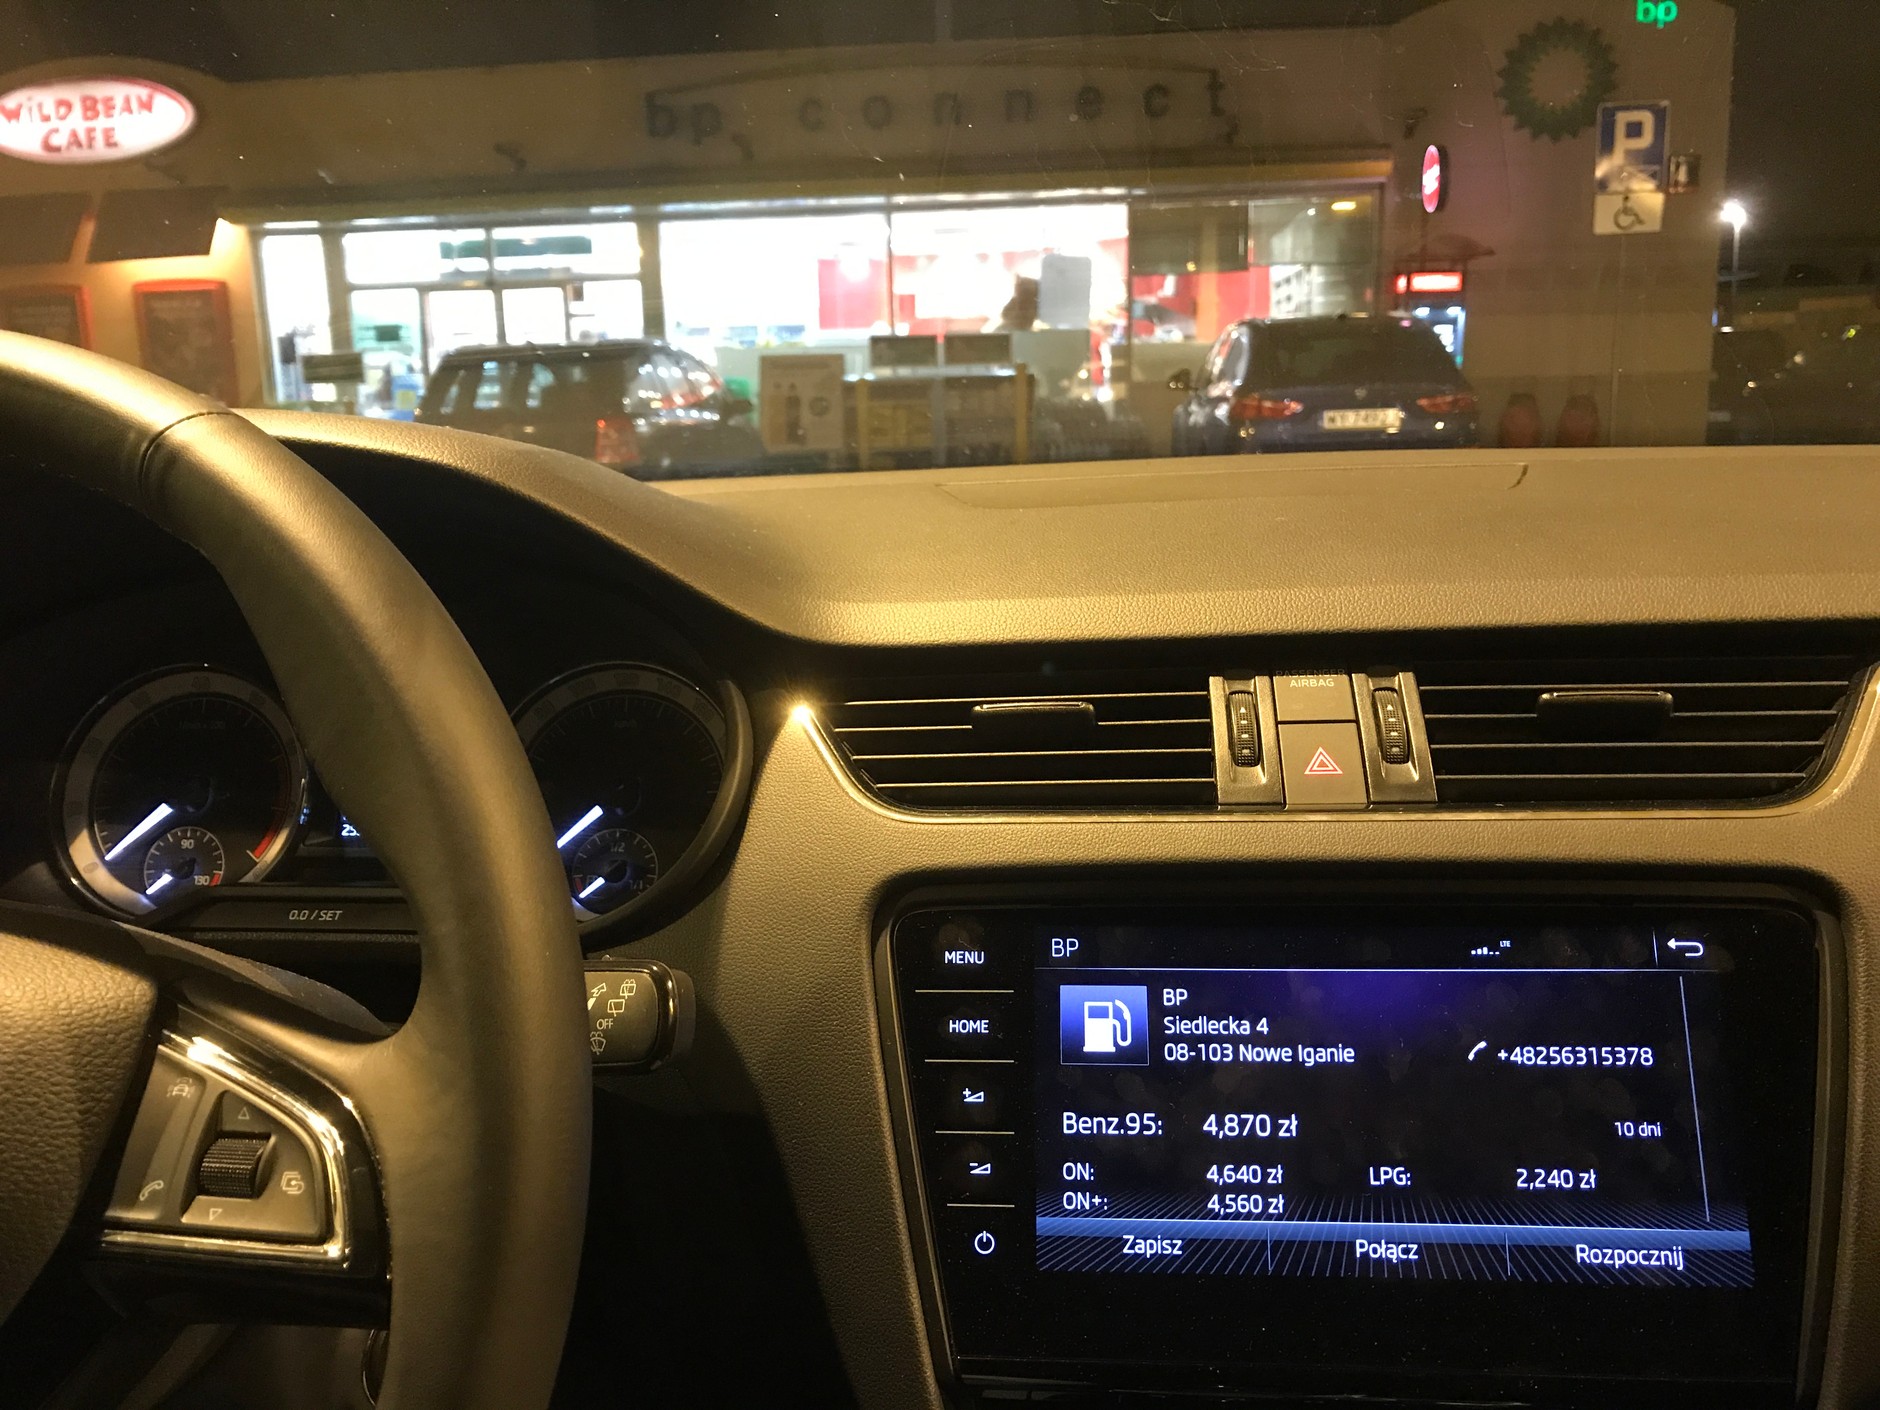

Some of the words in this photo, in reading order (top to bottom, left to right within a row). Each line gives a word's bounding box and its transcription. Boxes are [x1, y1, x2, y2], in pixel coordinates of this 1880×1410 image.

[1636, 0, 1678, 28] bp
[80, 90, 155, 121] BEAN
[645, 91, 723, 147] bp
[798, 70, 1226, 133] connect
[40, 127, 118, 152] CAFE
[1613, 110, 1655, 166] P
[1290, 679, 1335, 688] AIRBAG
[181, 839, 194, 849] 90
[611, 842, 625, 853] 1/2
[194, 875, 210, 885] 130
[289, 910, 309, 920] 0.0
[319, 910, 343, 921] SET
[1052, 938, 1078, 957] BP
[945, 951, 984, 964] MENU
[1163, 989, 1188, 1006] BP
[597, 1019, 614, 1030] OFF
[950, 1020, 989, 1033] HOME
[1164, 1016, 1250, 1035] Siedlecka
[1256, 1018, 1269, 1035] 4
[1165, 1043, 1233, 1062] 08-103
[1239, 1044, 1292, 1062] Nowe
[1298, 1044, 1355, 1066] Iganie
[1498, 1047, 1653, 1066] +48256315378
[1063, 1112, 1162, 1135] Benz.95:
[1203, 1114, 1271, 1139] 4,870
[1278, 1114, 1298, 1137] zł
[1615, 1122, 1634, 1136] 10
[1639, 1122, 1661, 1136] dni
[1063, 1163, 1094, 1180] ON:
[1207, 1165, 1261, 1185] 4,640
[1267, 1165, 1283, 1184] zł
[1370, 1167, 1411, 1185] LPG:
[1517, 1169, 1573, 1190] 2,240
[1579, 1169, 1596, 1188] zł
[1063, 1193, 1108, 1211] ON+:
[1207, 1195, 1264, 1214] 4,560
[1268, 1194, 1284, 1213] zł
[1123, 1235, 1182, 1258] Zapisz
[1356, 1239, 1418, 1263] Połącz
[1576, 1244, 1683, 1270] Rozpocznij
